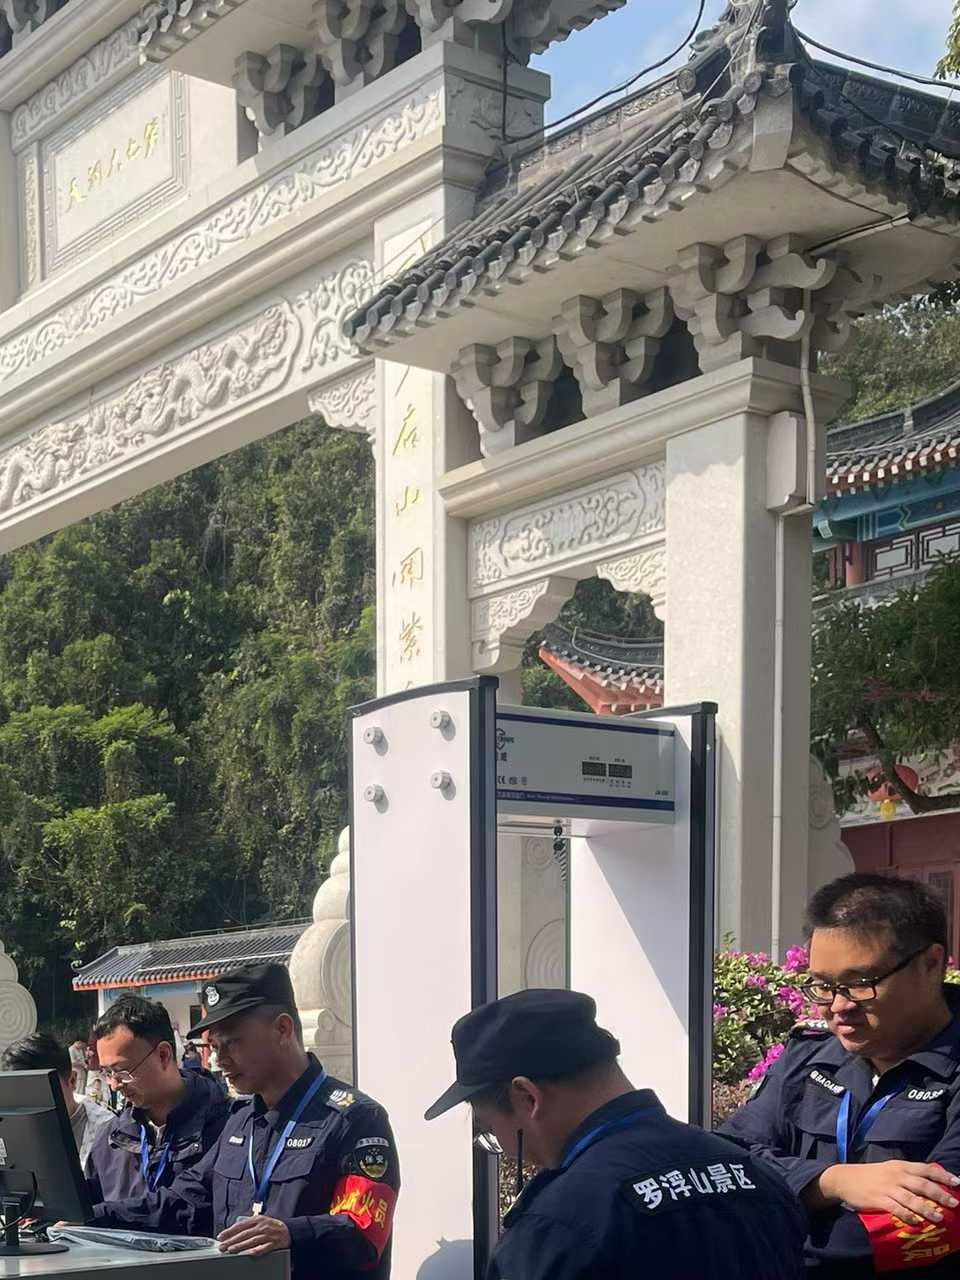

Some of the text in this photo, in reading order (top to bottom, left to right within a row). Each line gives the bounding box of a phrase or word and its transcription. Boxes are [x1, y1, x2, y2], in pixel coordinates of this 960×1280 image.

[632, 1163, 756, 1210] 罗浮山景区
